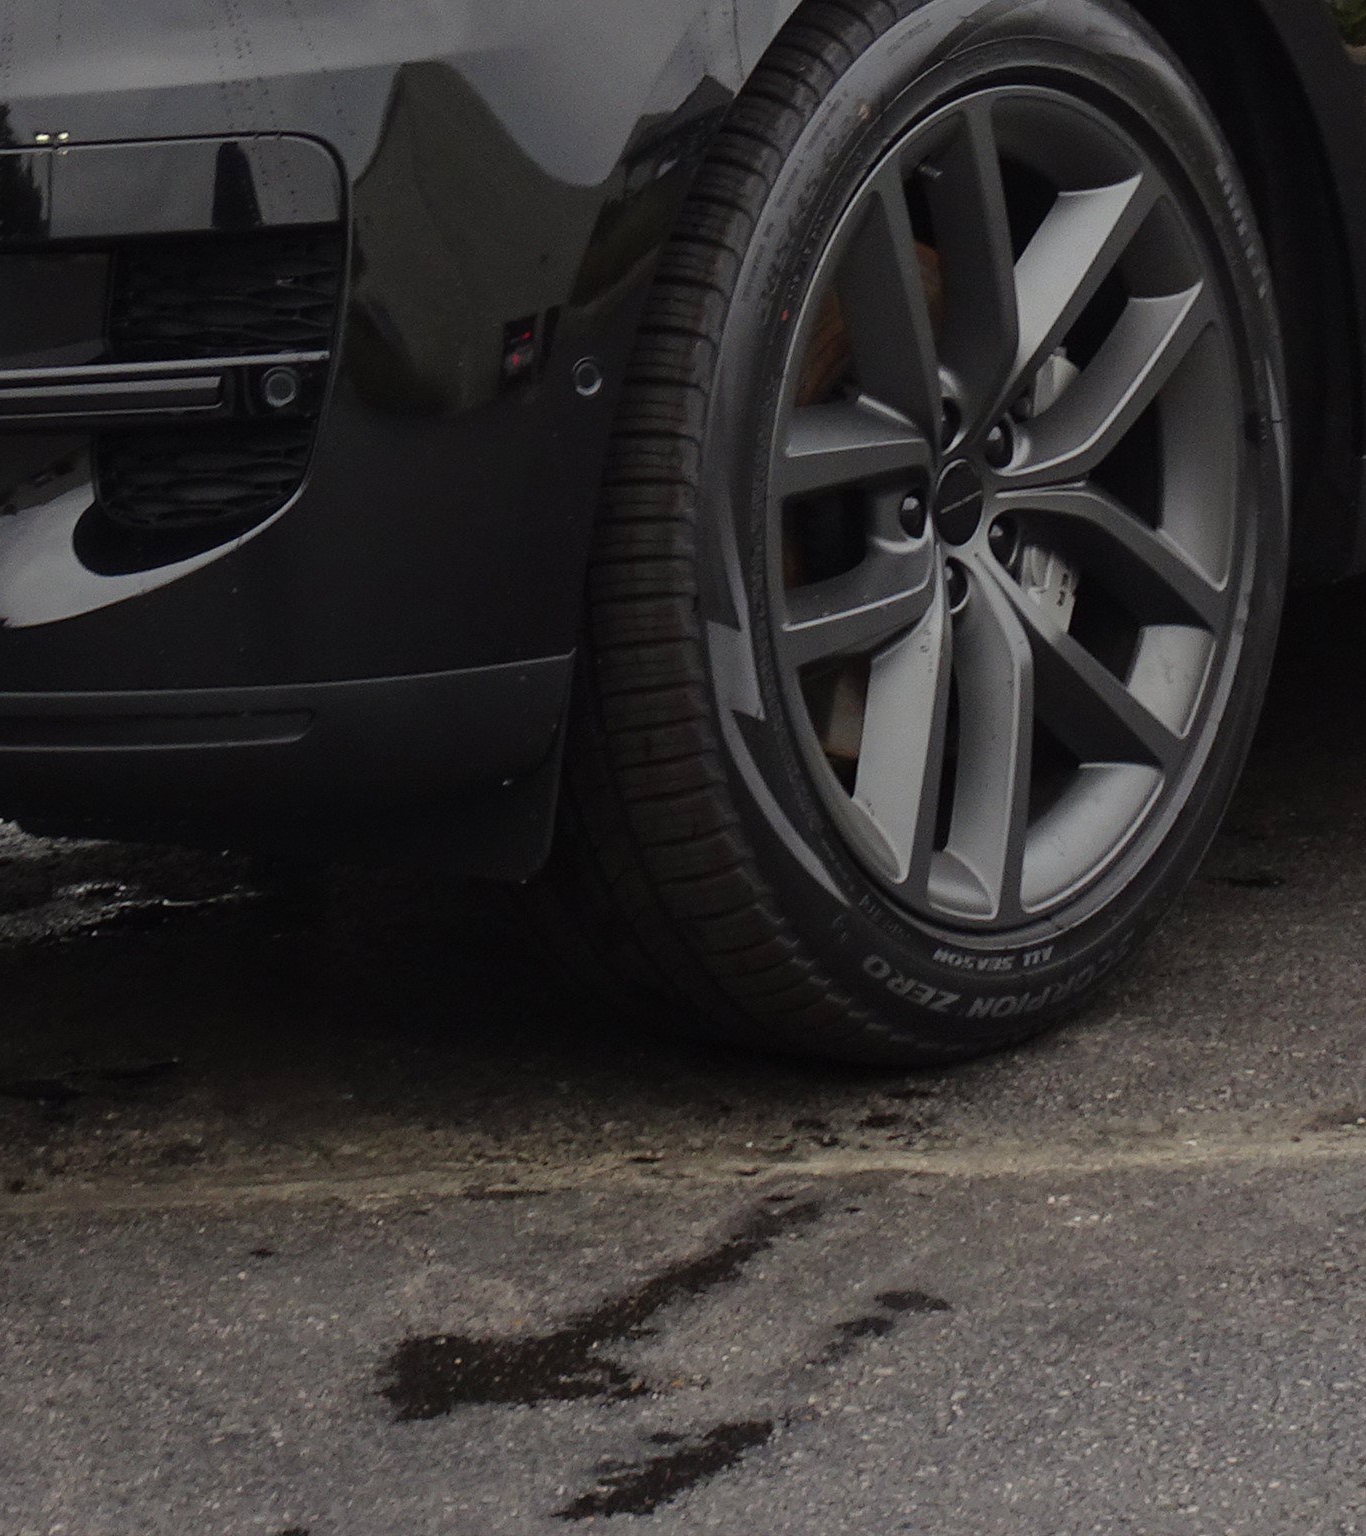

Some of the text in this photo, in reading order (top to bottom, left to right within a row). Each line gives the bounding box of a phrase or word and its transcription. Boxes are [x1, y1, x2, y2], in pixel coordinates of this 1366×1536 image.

[932, 945, 1055, 970] ALL SEASON
[863, 954, 961, 1013] ZERO
